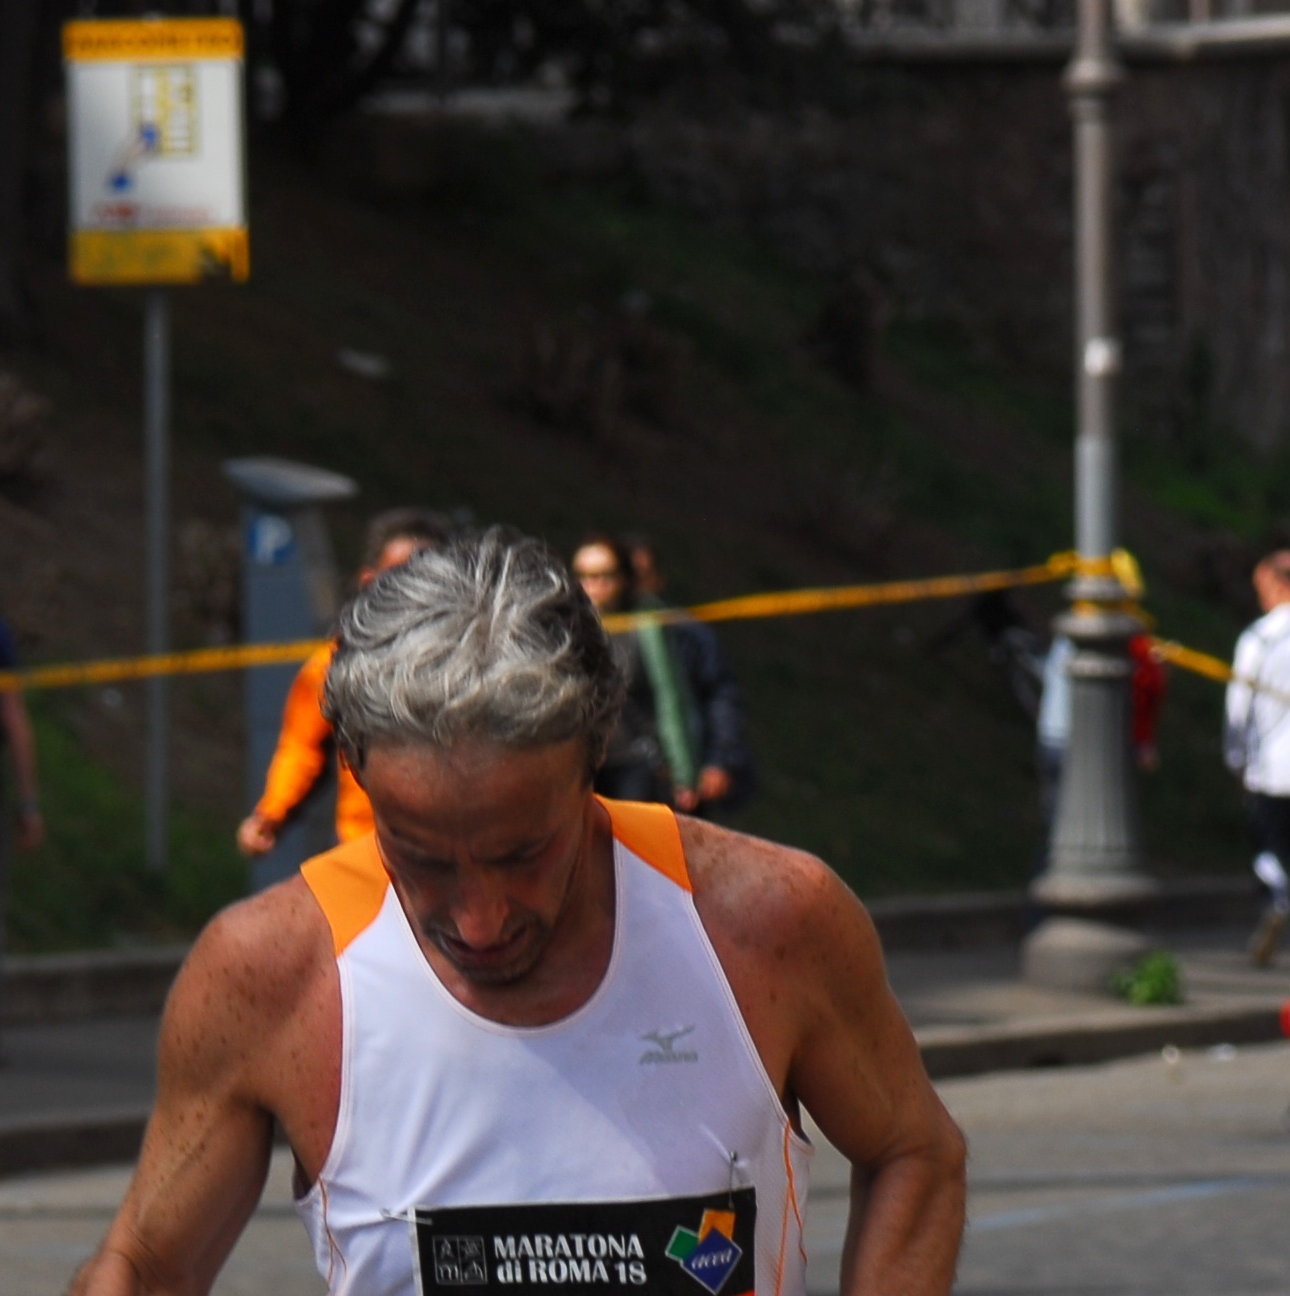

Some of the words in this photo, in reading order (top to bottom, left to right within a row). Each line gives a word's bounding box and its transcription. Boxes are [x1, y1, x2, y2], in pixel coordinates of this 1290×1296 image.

[494, 1234, 645, 1259] MARATONA
[497, 1259, 523, 1284] di
[528, 1258, 609, 1284] ROMA
[614, 1260, 648, 1285] 18
